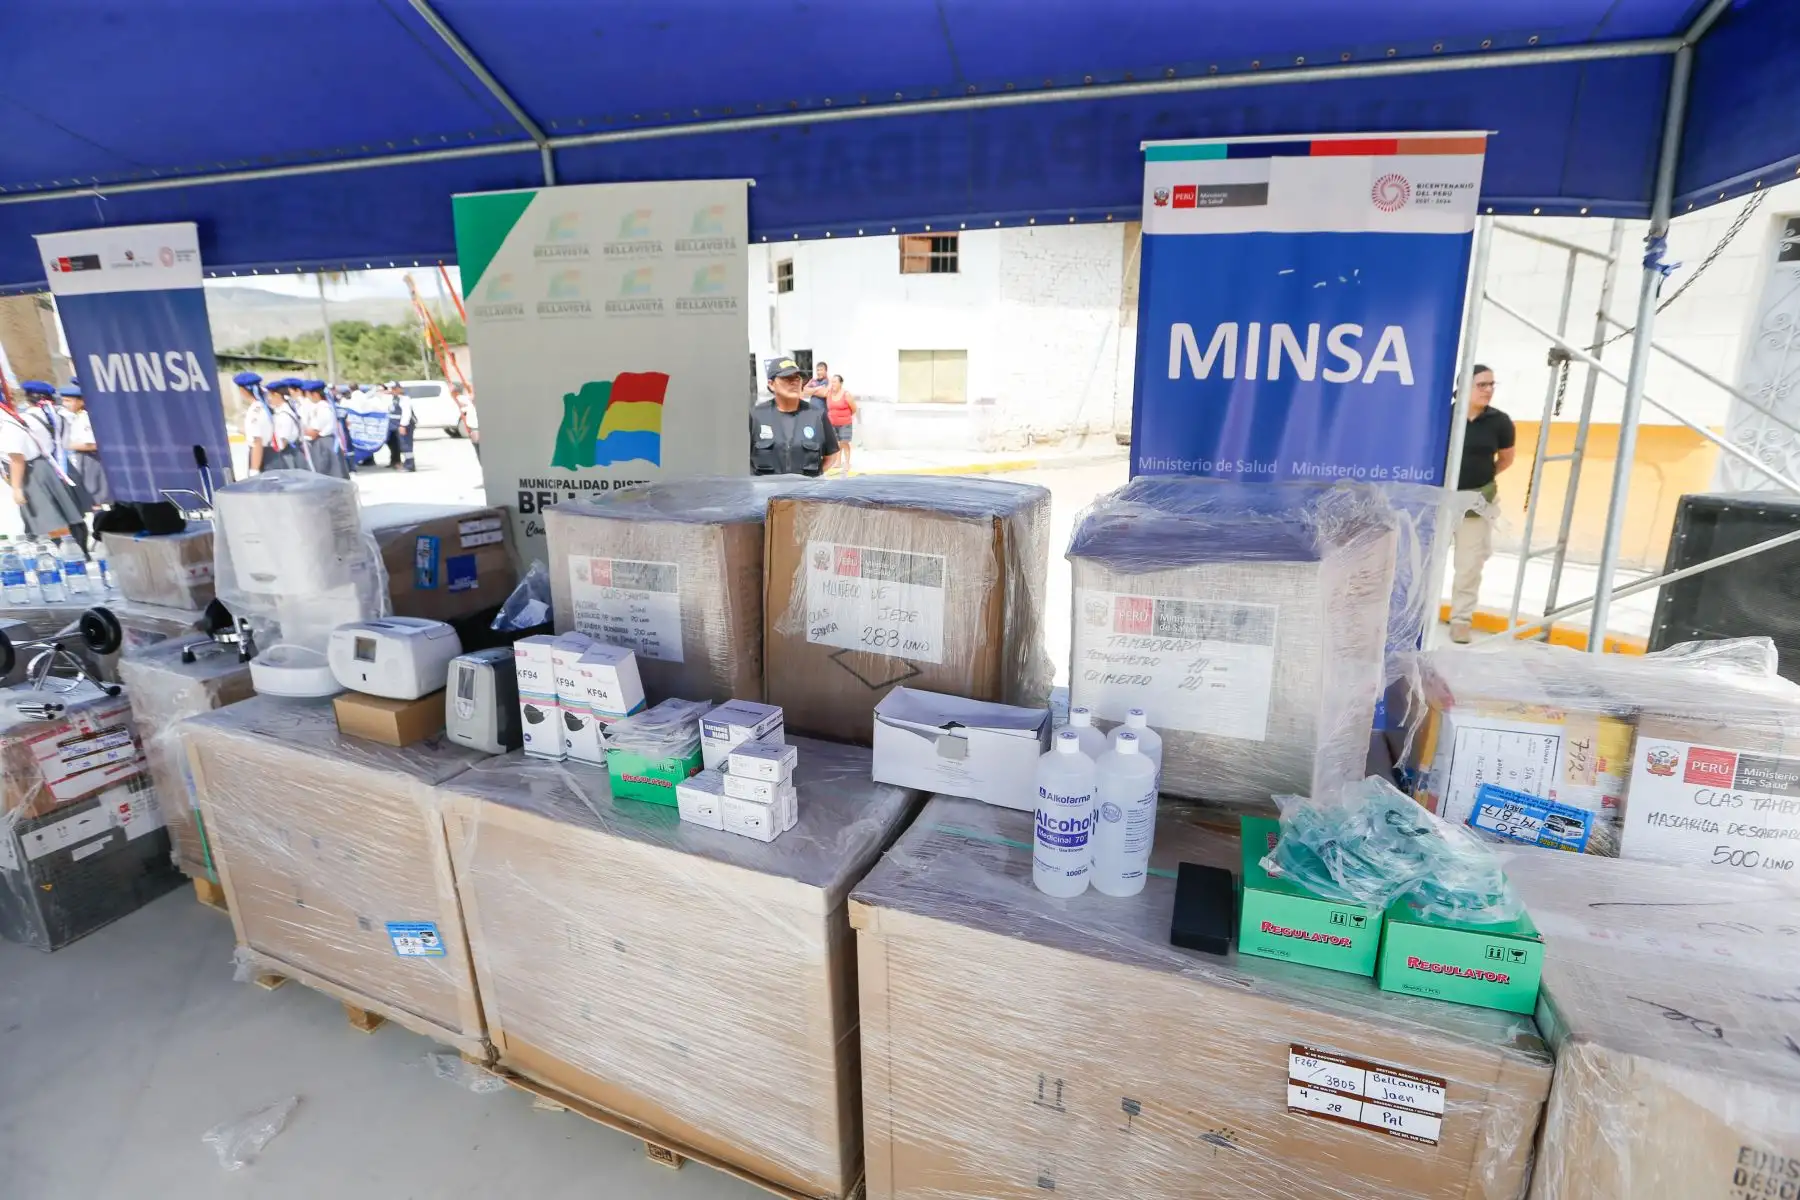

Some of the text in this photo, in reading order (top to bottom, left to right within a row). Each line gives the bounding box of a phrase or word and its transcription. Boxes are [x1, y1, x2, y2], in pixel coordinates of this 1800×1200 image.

[1168, 322, 1414, 385] MINSA
[89, 351, 210, 393] MINSA
[1139, 456, 1278, 474] Ministerio de Salud
[1292, 461, 1434, 481] Ministerio de Salud
[519, 478, 609, 490] MUNICIPALIDAD
[861, 626, 900, 648] 288
[517, 669, 538, 679] KF94
[586, 688, 609, 699] KF94
[1691, 760, 1729, 775] PERÚ
[1744, 768, 1799, 781] Ministerio
[1742, 777, 1788, 790] de Salud
[1046, 793, 1091, 804] Alkofarma
[1694, 789, 1744, 808] CLAS
[1036, 808, 1092, 832] Alcohol
[1038, 828, 1072, 844] Medicinal
[1711, 846, 1760, 868] 500
[1066, 869, 1081, 877] 1000
[1261, 920, 1352, 948] REGULATOR
[1407, 955, 1511, 985] REGULATOR
[1295, 1057, 1318, 1068] F262
[1300, 1089, 1308, 1098] 4
[1382, 1087, 1414, 1103] Jaen
[1326, 1103, 1342, 1113] 28
